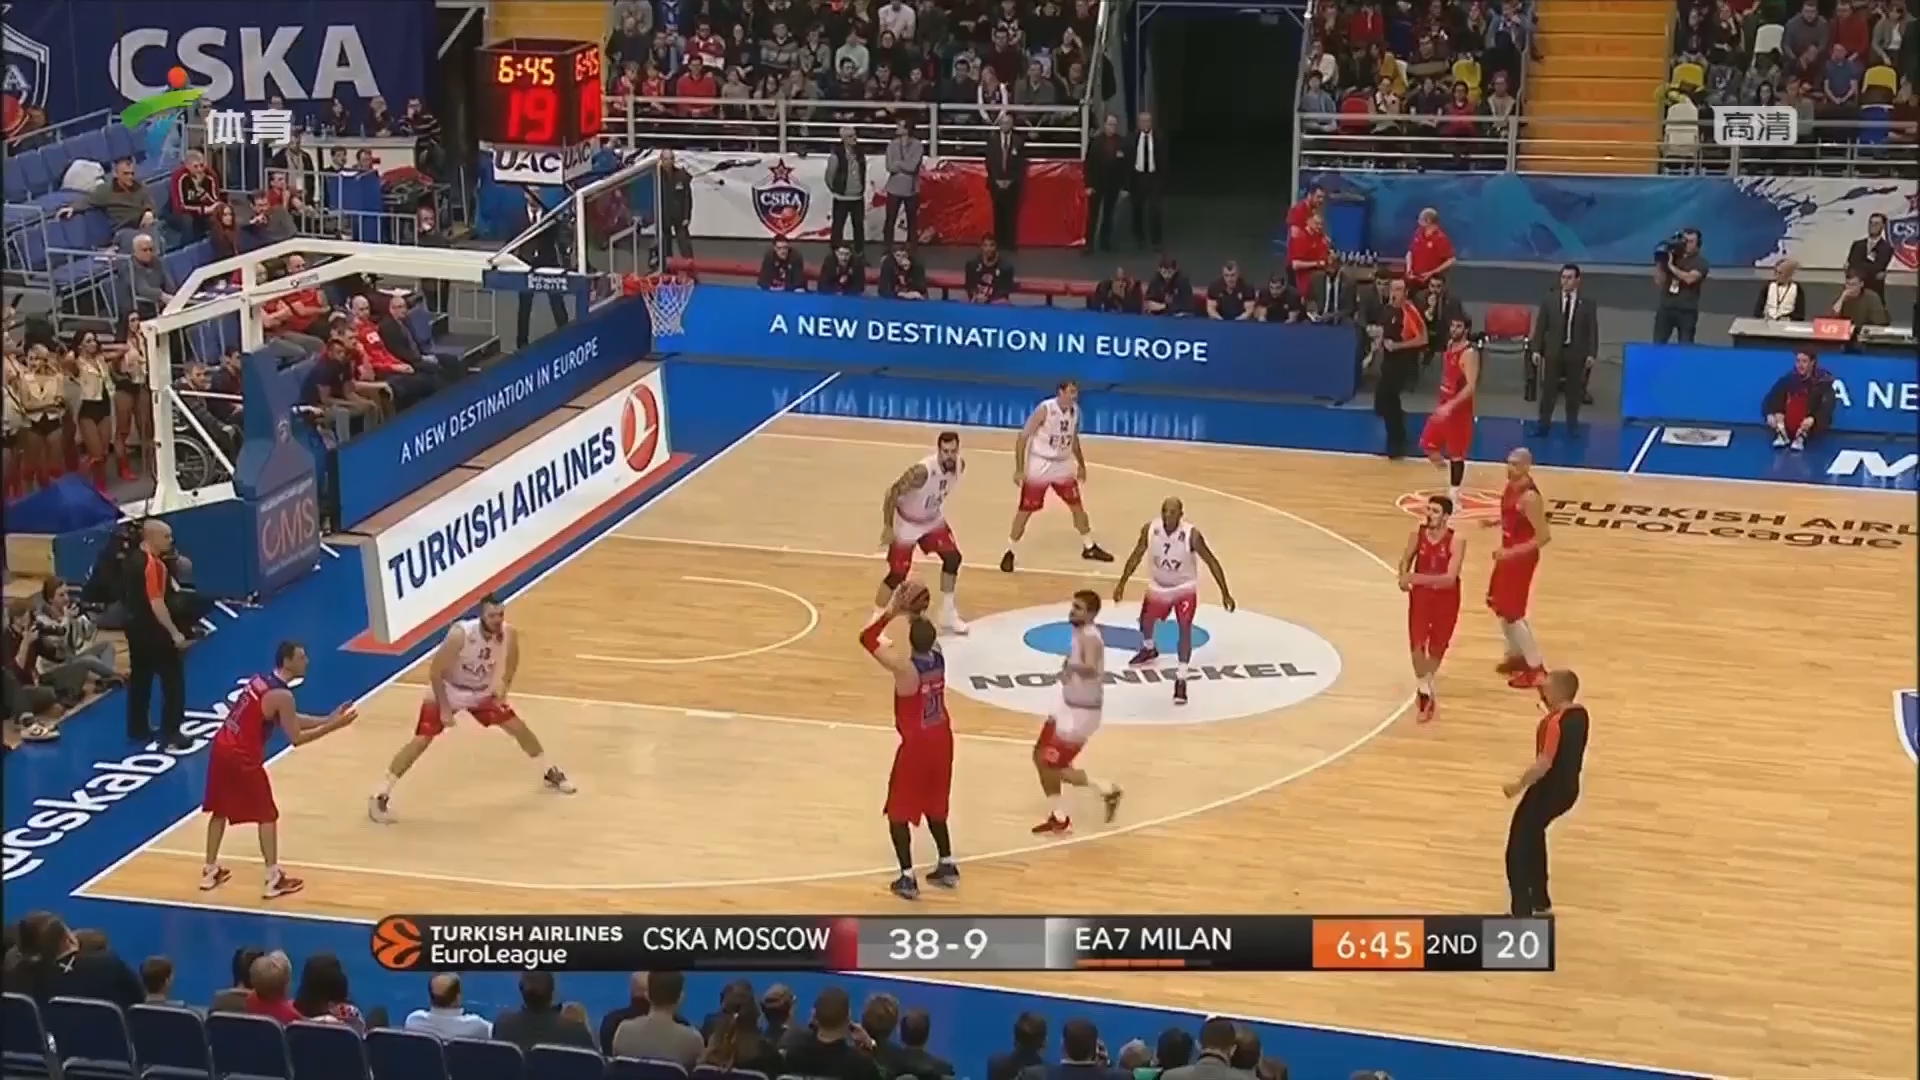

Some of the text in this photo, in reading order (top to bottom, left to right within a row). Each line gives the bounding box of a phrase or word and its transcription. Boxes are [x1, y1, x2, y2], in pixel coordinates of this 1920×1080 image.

[109, 25, 382, 101] CSKA
[498, 55, 555, 86] 6:45
[506, 87, 558, 142] 19
[493, 149, 562, 173] UAC
[760, 191, 802, 206] CSKA
[769, 313, 1209, 362] A NEW DESTINATION IN EUROPE
[400, 336, 600, 465] A NEW DESTINATION IN EUROPE
[387, 426, 617, 601] TURKISH AIRLINES
[1544, 510, 1904, 550] EuroLeague
[1548, 498, 1788, 527] TURKISH
